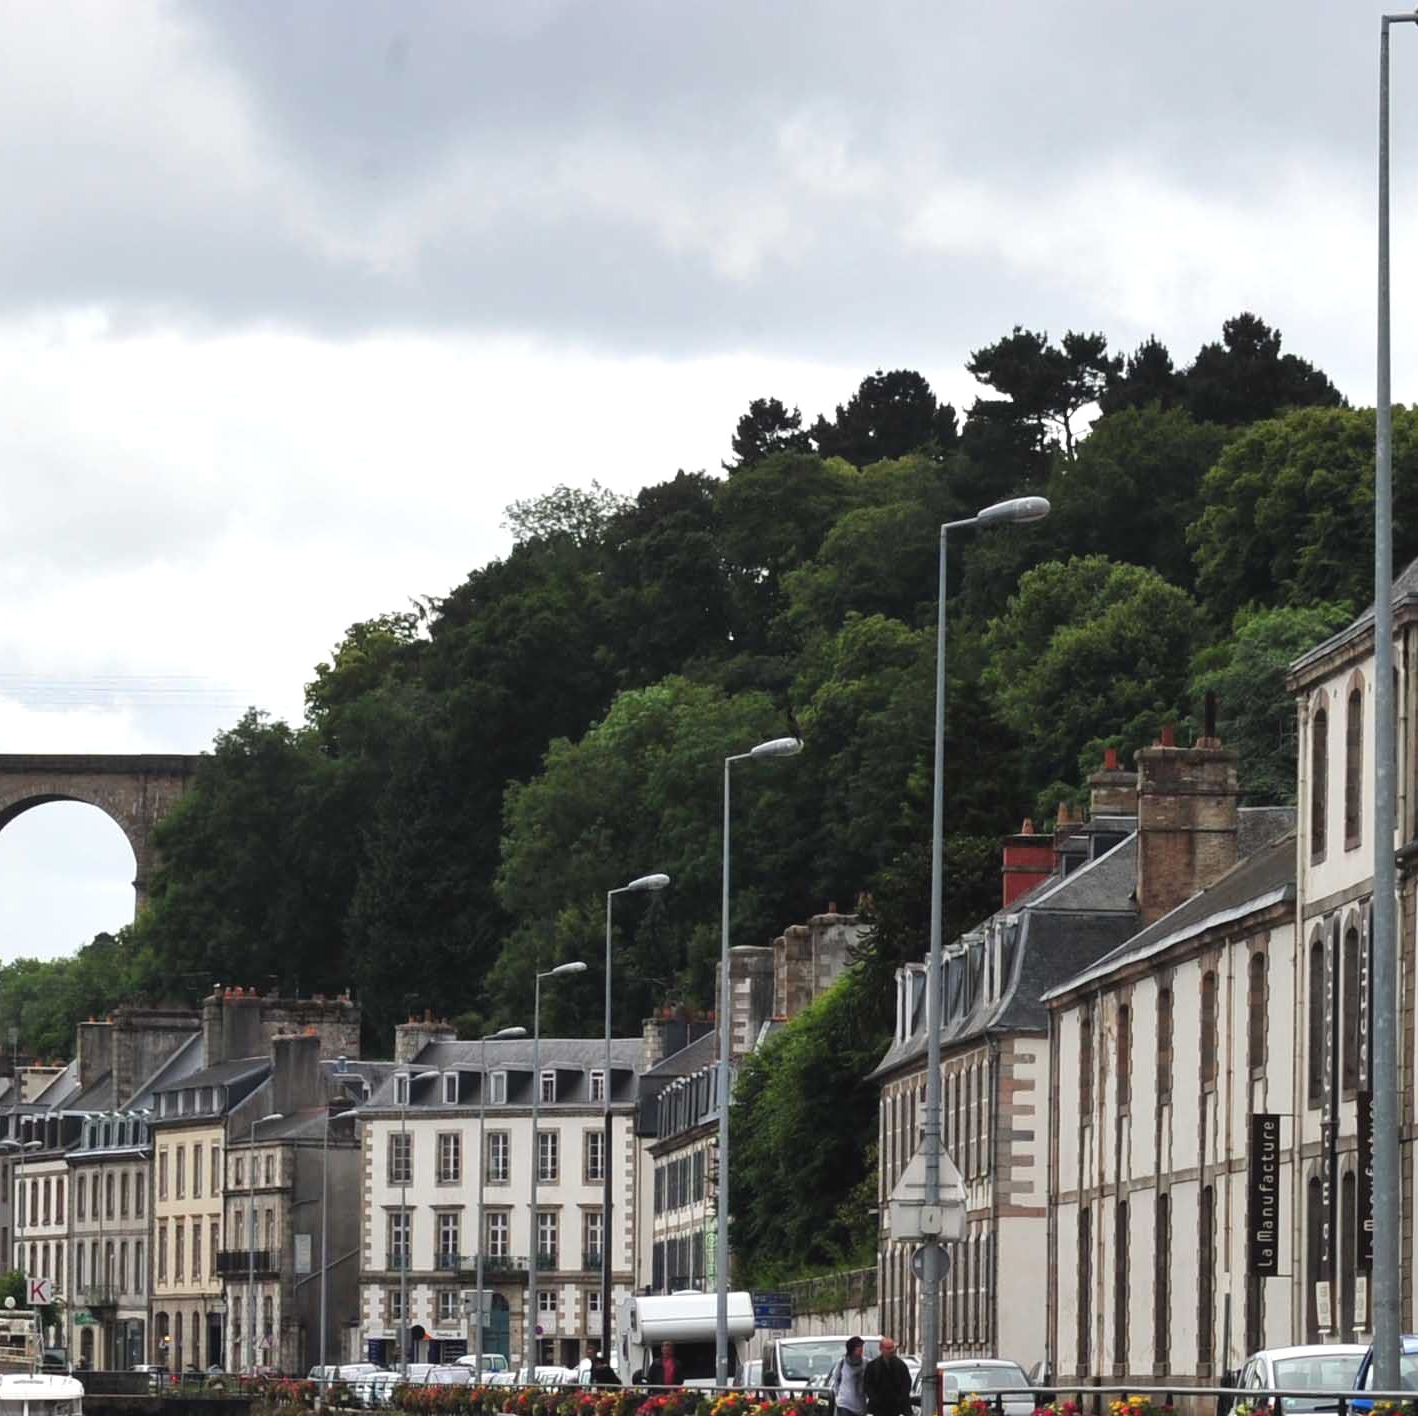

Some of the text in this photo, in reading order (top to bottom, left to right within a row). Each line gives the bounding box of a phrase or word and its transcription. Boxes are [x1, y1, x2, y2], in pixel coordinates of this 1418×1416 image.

[1256, 1121, 1275, 1266] La Manufacture
[31, 1280, 47, 1302] K
